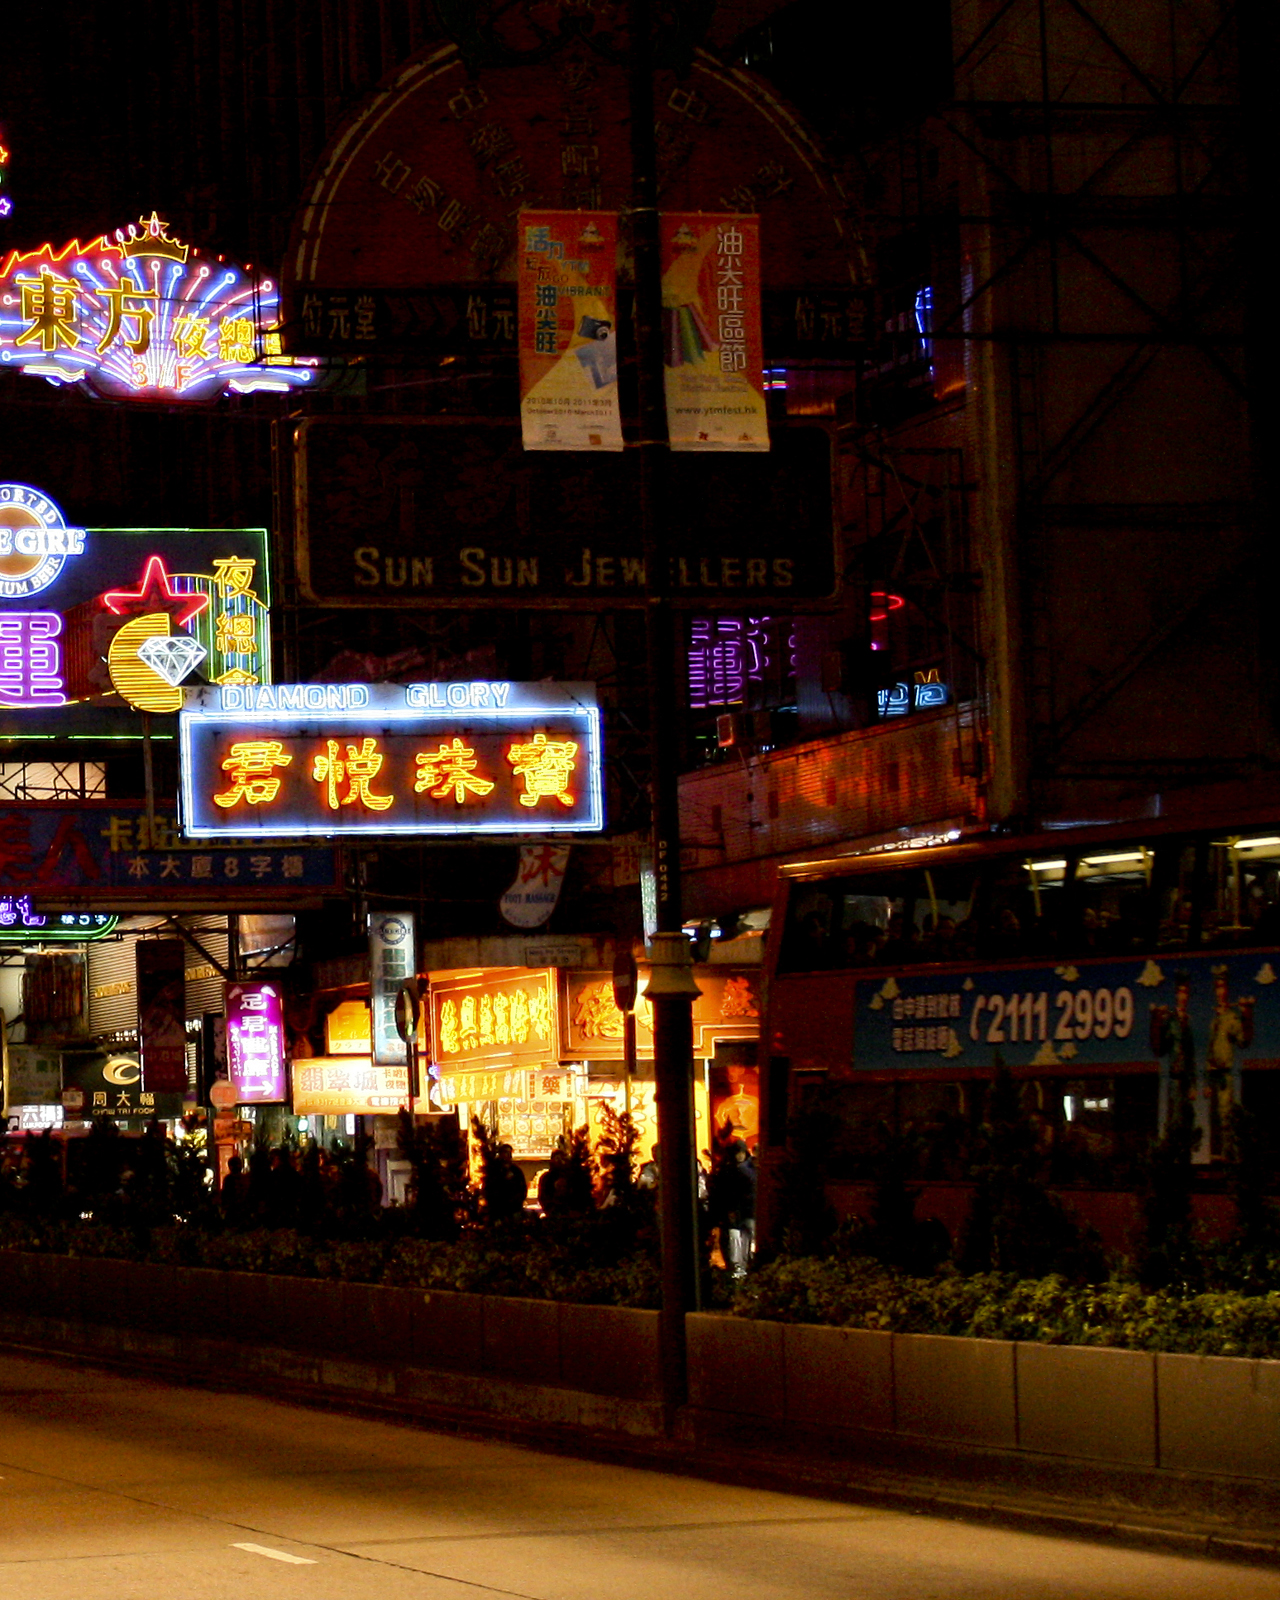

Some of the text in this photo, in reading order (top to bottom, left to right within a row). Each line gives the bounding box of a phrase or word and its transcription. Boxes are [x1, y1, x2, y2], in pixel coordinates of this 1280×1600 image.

[15, 273, 160, 355] 東方
[717, 225, 746, 372] 油尖旺區節
[30, 556, 62, 589] BEER
[565, 547, 796, 588] JEWLLERS
[222, 682, 510, 710] DIAMOND GLORY
[213, 733, 580, 811] 君悅珠寶
[986, 991, 1049, 1043] 2111
[1054, 986, 1134, 1041] 2999
[92, 1090, 155, 1107] 周大福
